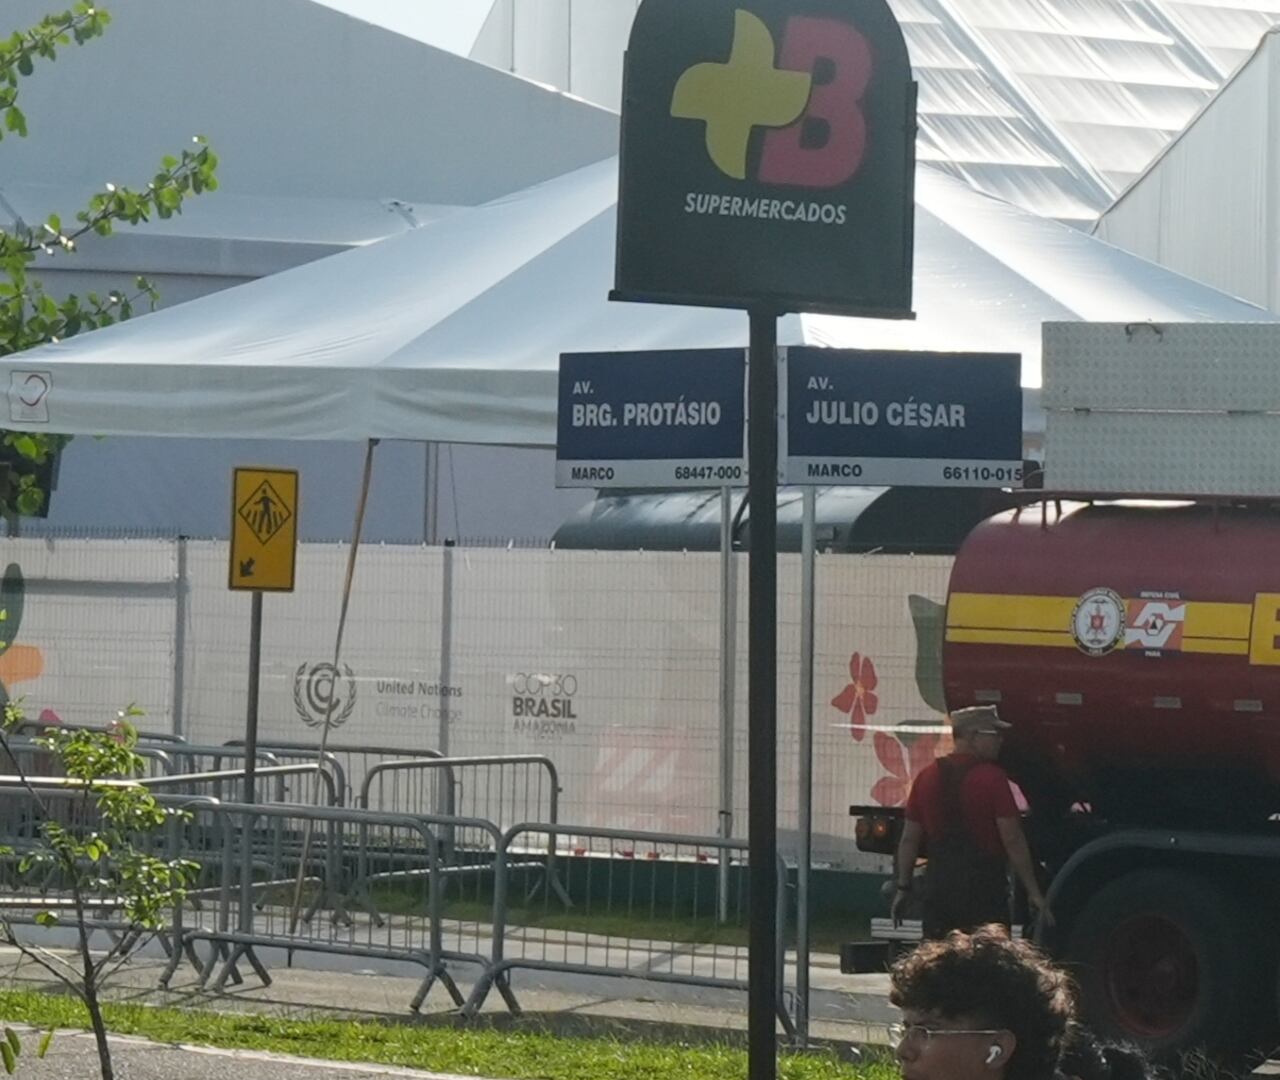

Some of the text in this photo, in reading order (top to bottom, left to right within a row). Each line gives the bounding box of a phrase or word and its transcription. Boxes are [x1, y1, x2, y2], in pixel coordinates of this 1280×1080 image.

[684, 192, 847, 225] SUPERMERCADOS
[572, 381, 594, 395] AV.
[807, 376, 834, 390] AV.
[572, 395, 721, 427] BRG. PROTÁSIO
[806, 396, 966, 428] JULIO CÉSAR
[571, 465, 741, 480] MARCO 68447-000
[807, 463, 1022, 481] MARCO 66110-015
[377, 680, 463, 698] United Nations
[512, 672, 578, 697] COP30
[512, 697, 578, 719] BRASIL
